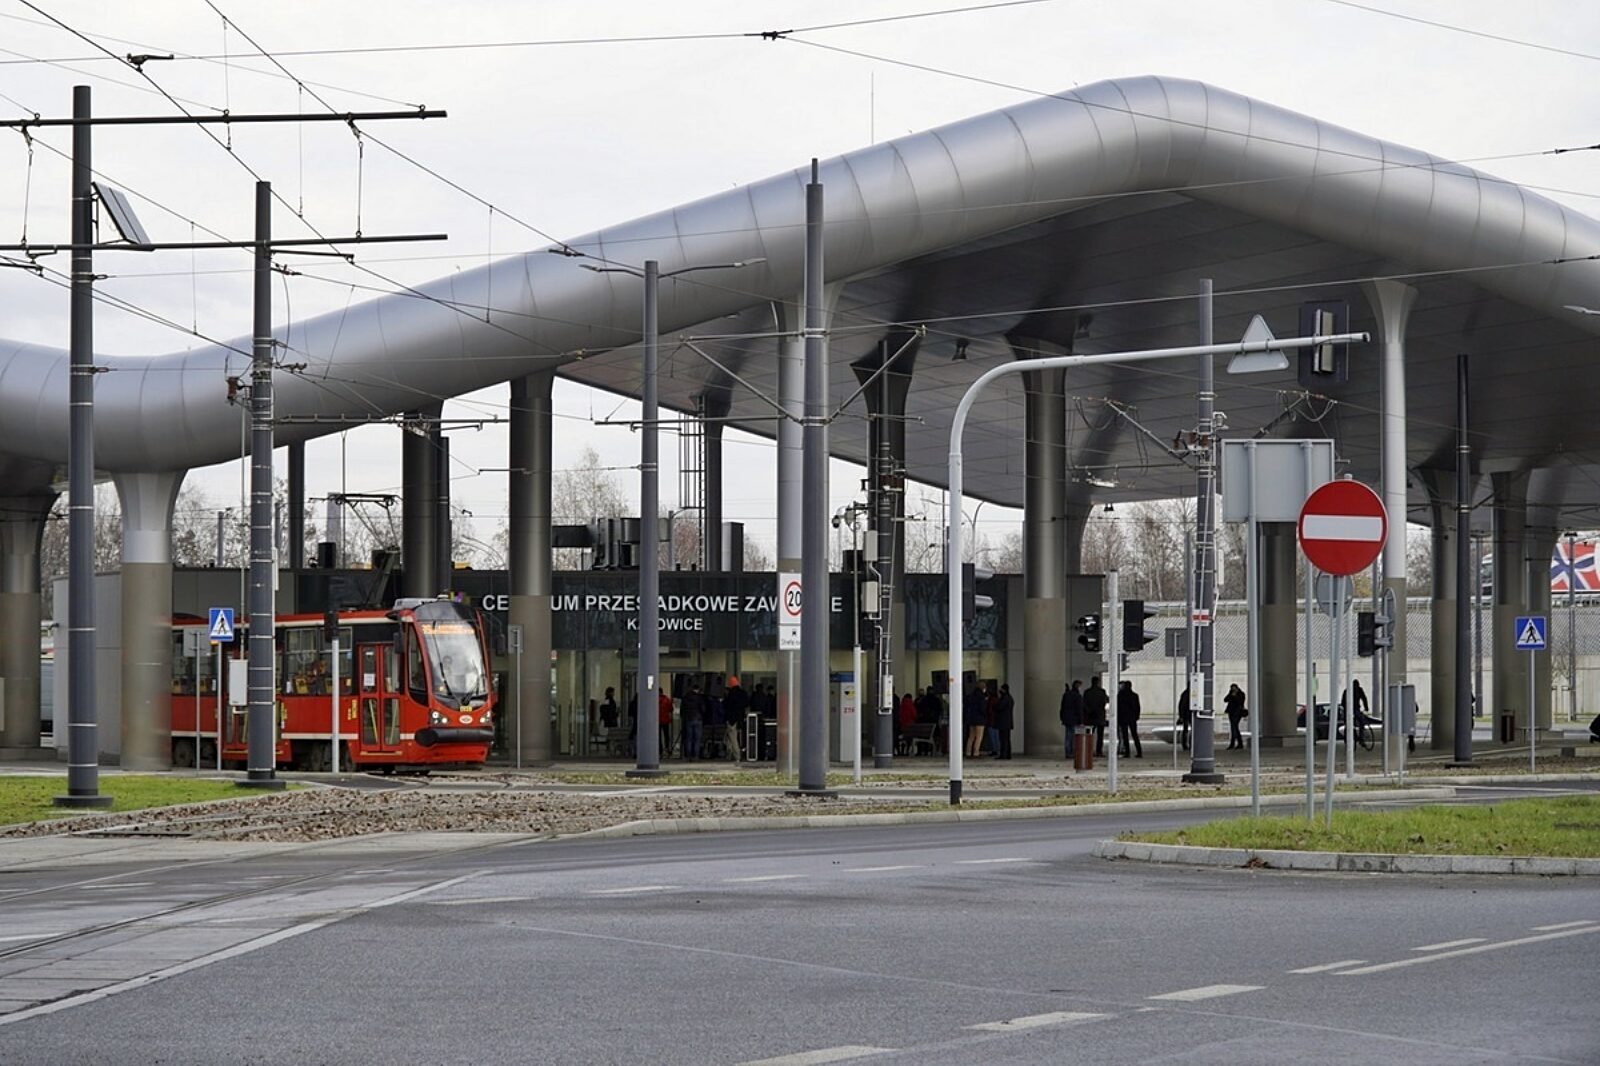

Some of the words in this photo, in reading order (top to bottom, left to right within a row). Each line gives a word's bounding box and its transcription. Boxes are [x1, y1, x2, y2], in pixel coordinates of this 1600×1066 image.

[482, 594, 578, 611] CEUM
[585, 595, 739, 611] PRZEADKOWE
[787, 590, 802, 607] 20
[627, 618, 703, 631] KOWICE
